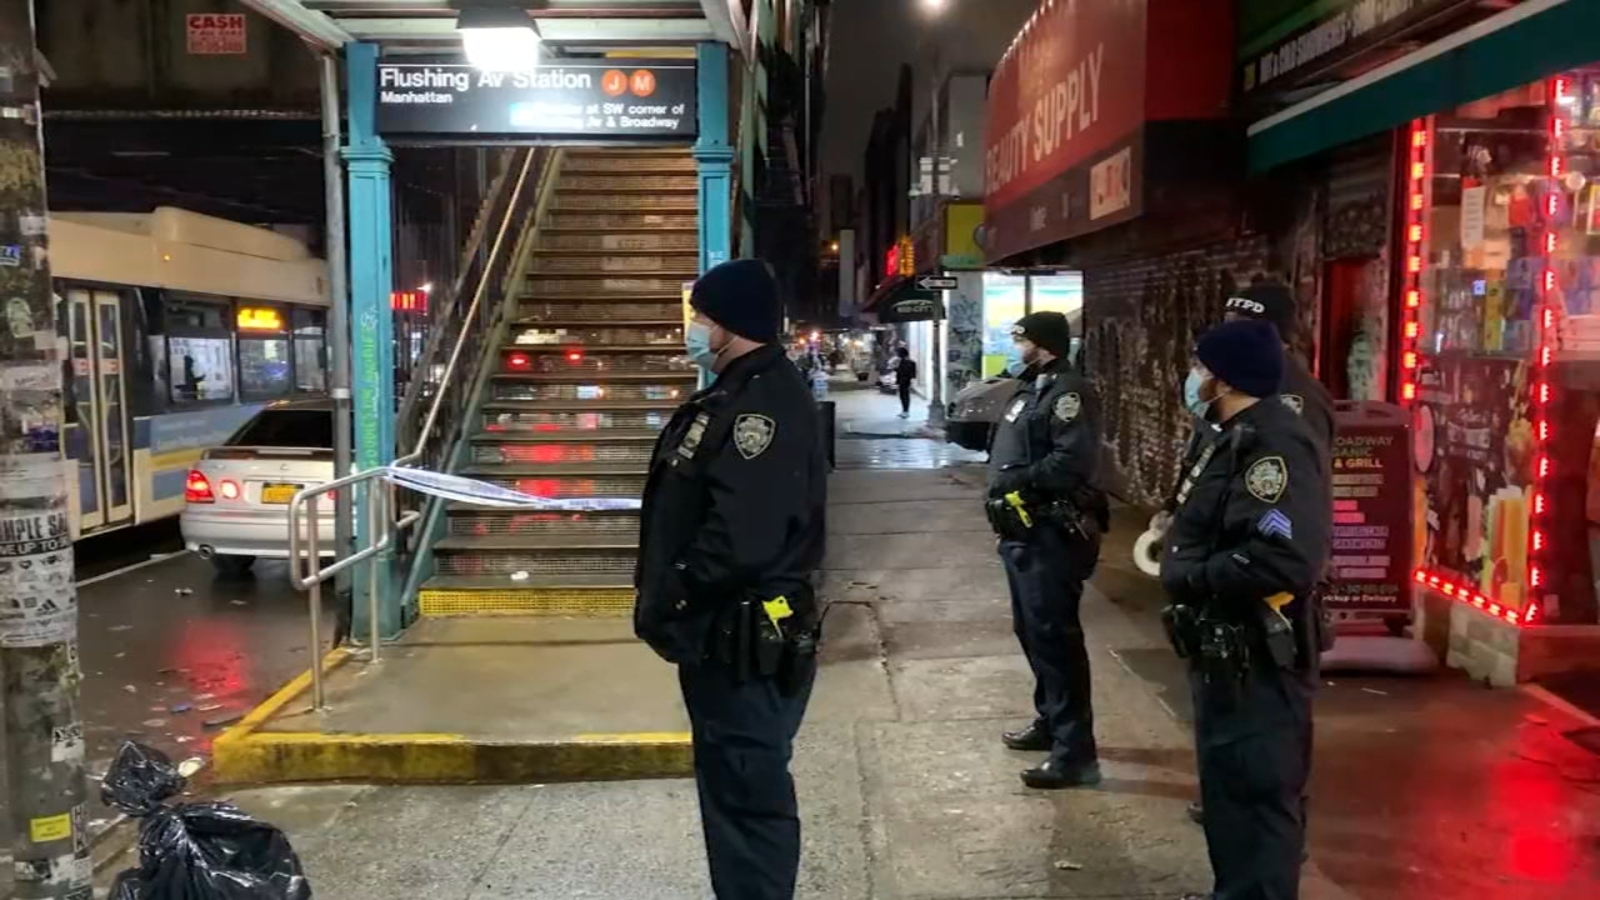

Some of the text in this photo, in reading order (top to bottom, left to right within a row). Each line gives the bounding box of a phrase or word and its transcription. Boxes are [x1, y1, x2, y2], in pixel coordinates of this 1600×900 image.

[189, 16, 242, 29] CASH
[380, 69, 469, 91] Flushing
[478, 70, 504, 88] Av
[513, 70, 592, 89] Station
[381, 92, 453, 103] Manhattan
[586, 104, 685, 115] at SW corner of
[606, 117, 616, 128] &
[620, 116, 680, 130] Broadway
[986, 113, 1031, 195] BEAUTY
[1033, 43, 1104, 162] SUPPLY
[1334, 458, 1384, 468] & GRILL
[40, 539, 58, 551] TO
